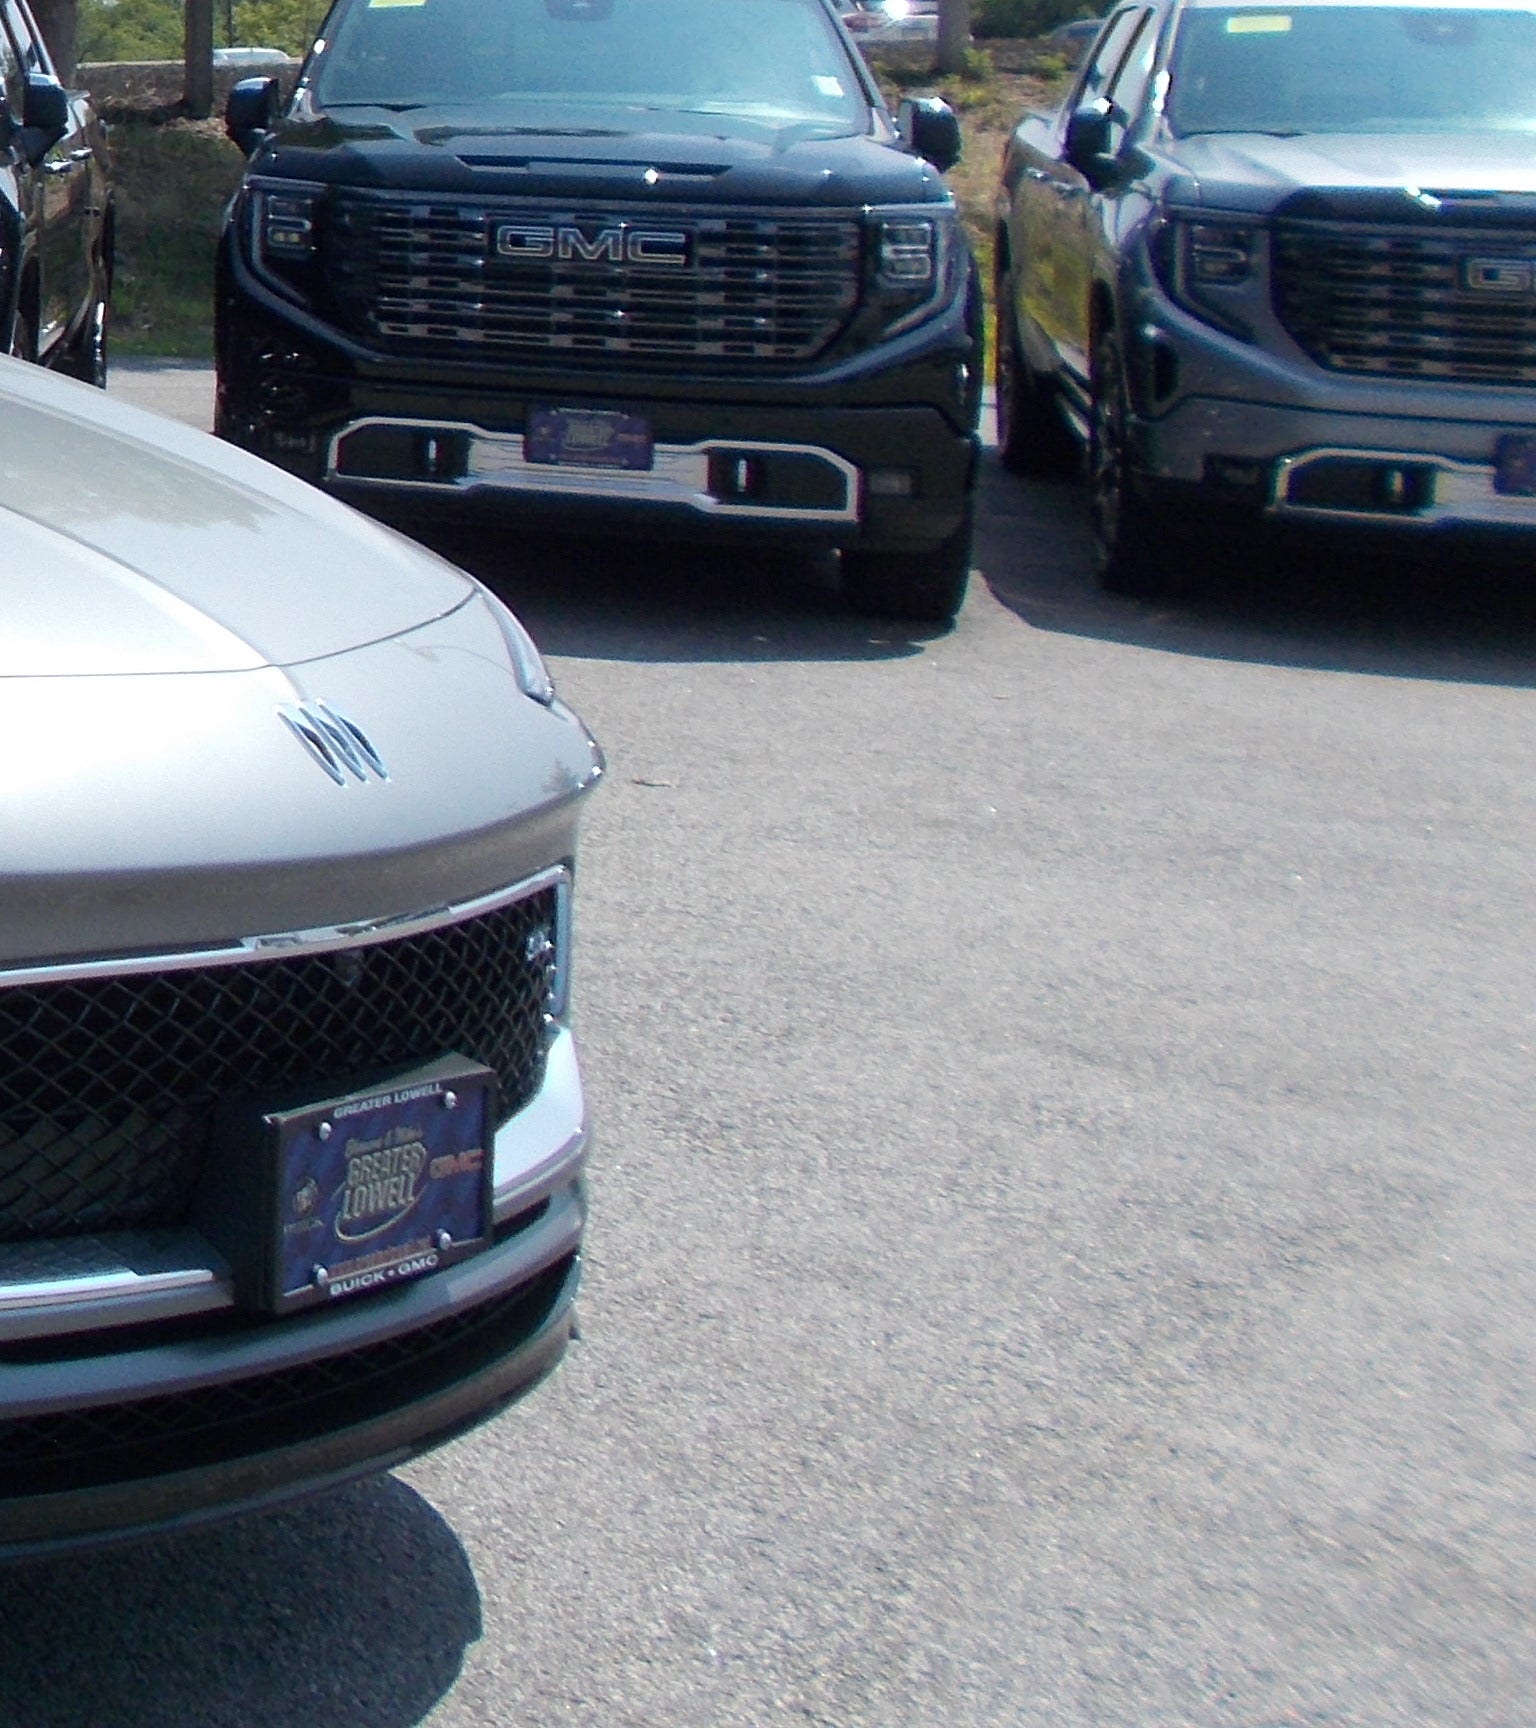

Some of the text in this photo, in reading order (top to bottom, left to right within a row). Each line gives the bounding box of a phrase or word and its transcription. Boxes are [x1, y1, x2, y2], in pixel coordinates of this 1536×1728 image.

[496, 224, 687, 265] GMC
[332, 1083, 443, 1119] GREATER LOWELL
[347, 1140, 427, 1188] GREATER
[341, 1172, 416, 1220] LOWELL
[329, 1268, 387, 1297] BUICK
[397, 1253, 440, 1276] GMC
